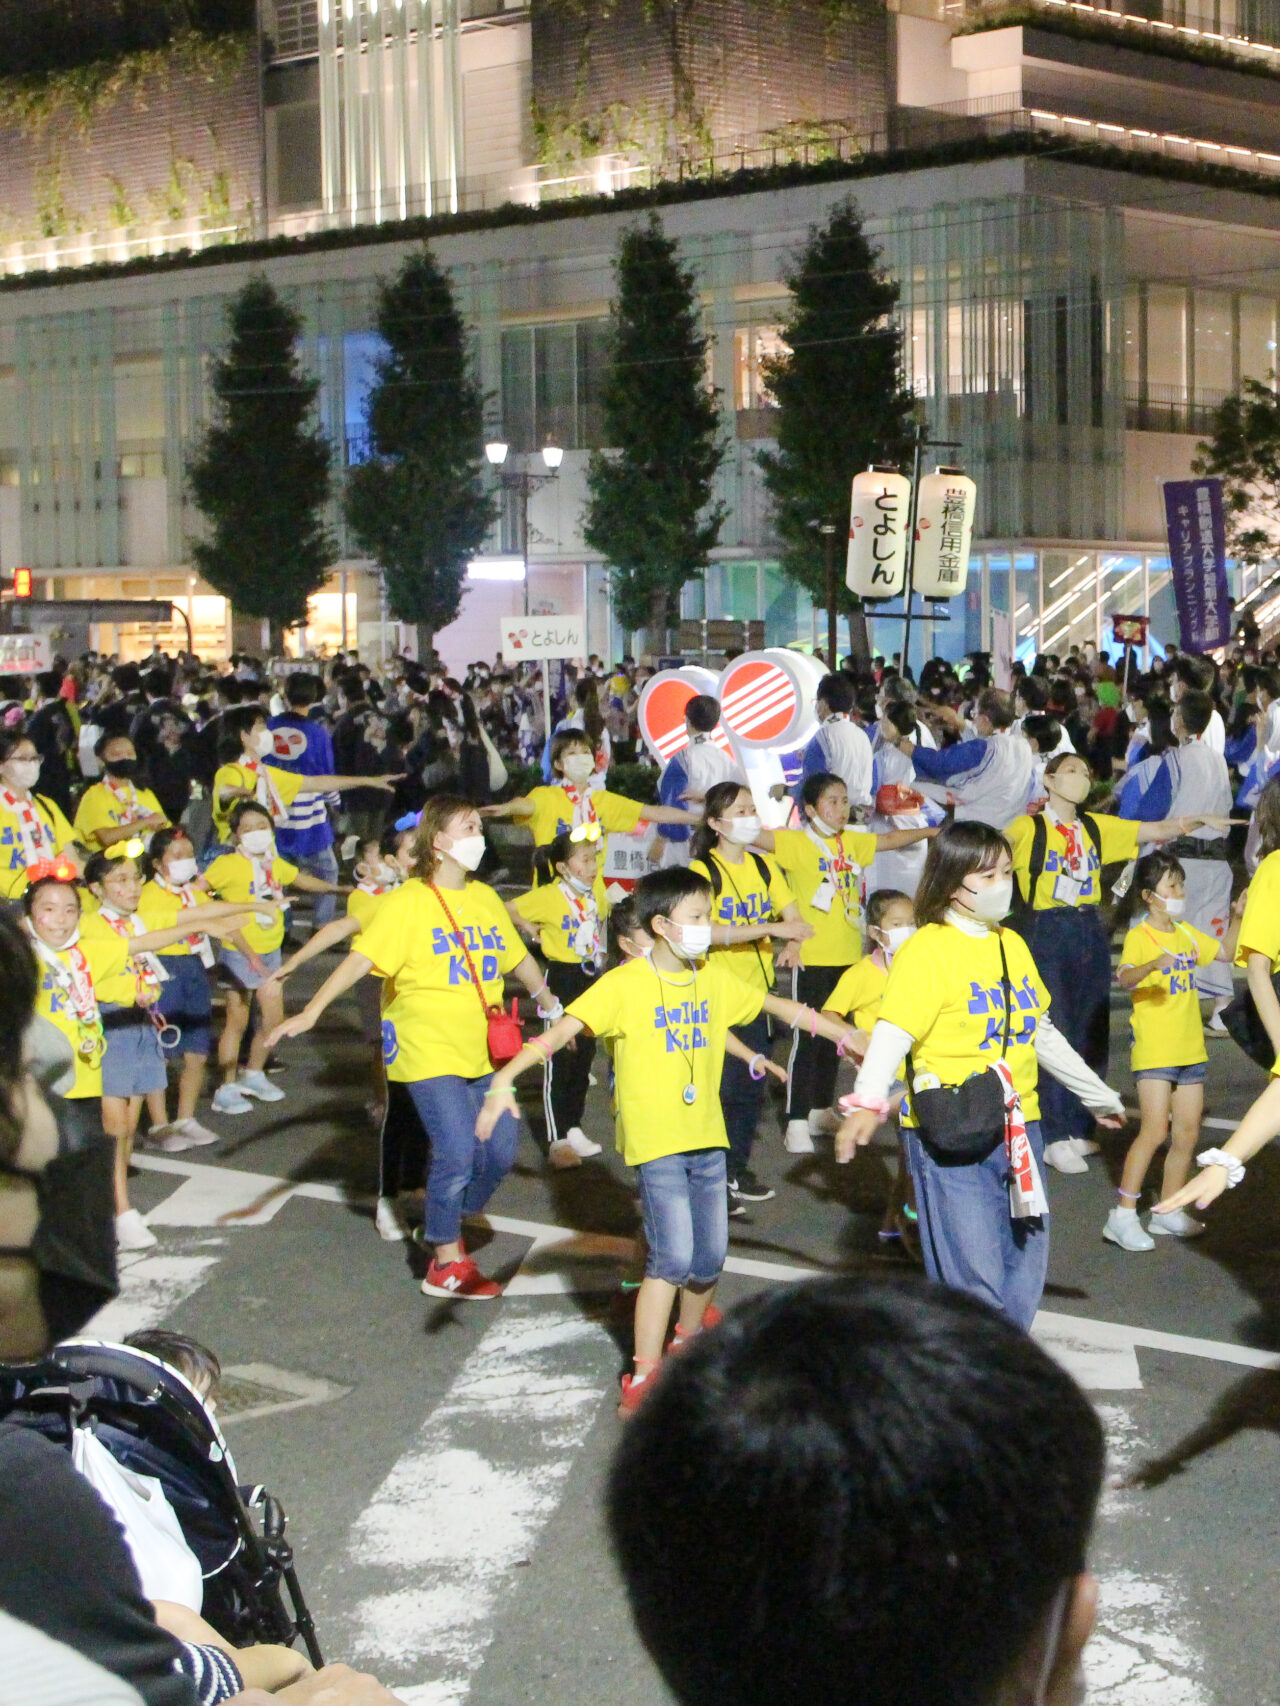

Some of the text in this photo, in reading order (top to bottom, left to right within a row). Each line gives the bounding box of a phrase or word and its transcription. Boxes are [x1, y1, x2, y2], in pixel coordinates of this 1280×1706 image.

[871, 487, 898, 584] とよしん
[937, 487, 967, 583] 豊橋信用金庫
[531, 629, 578, 647] とよしん
